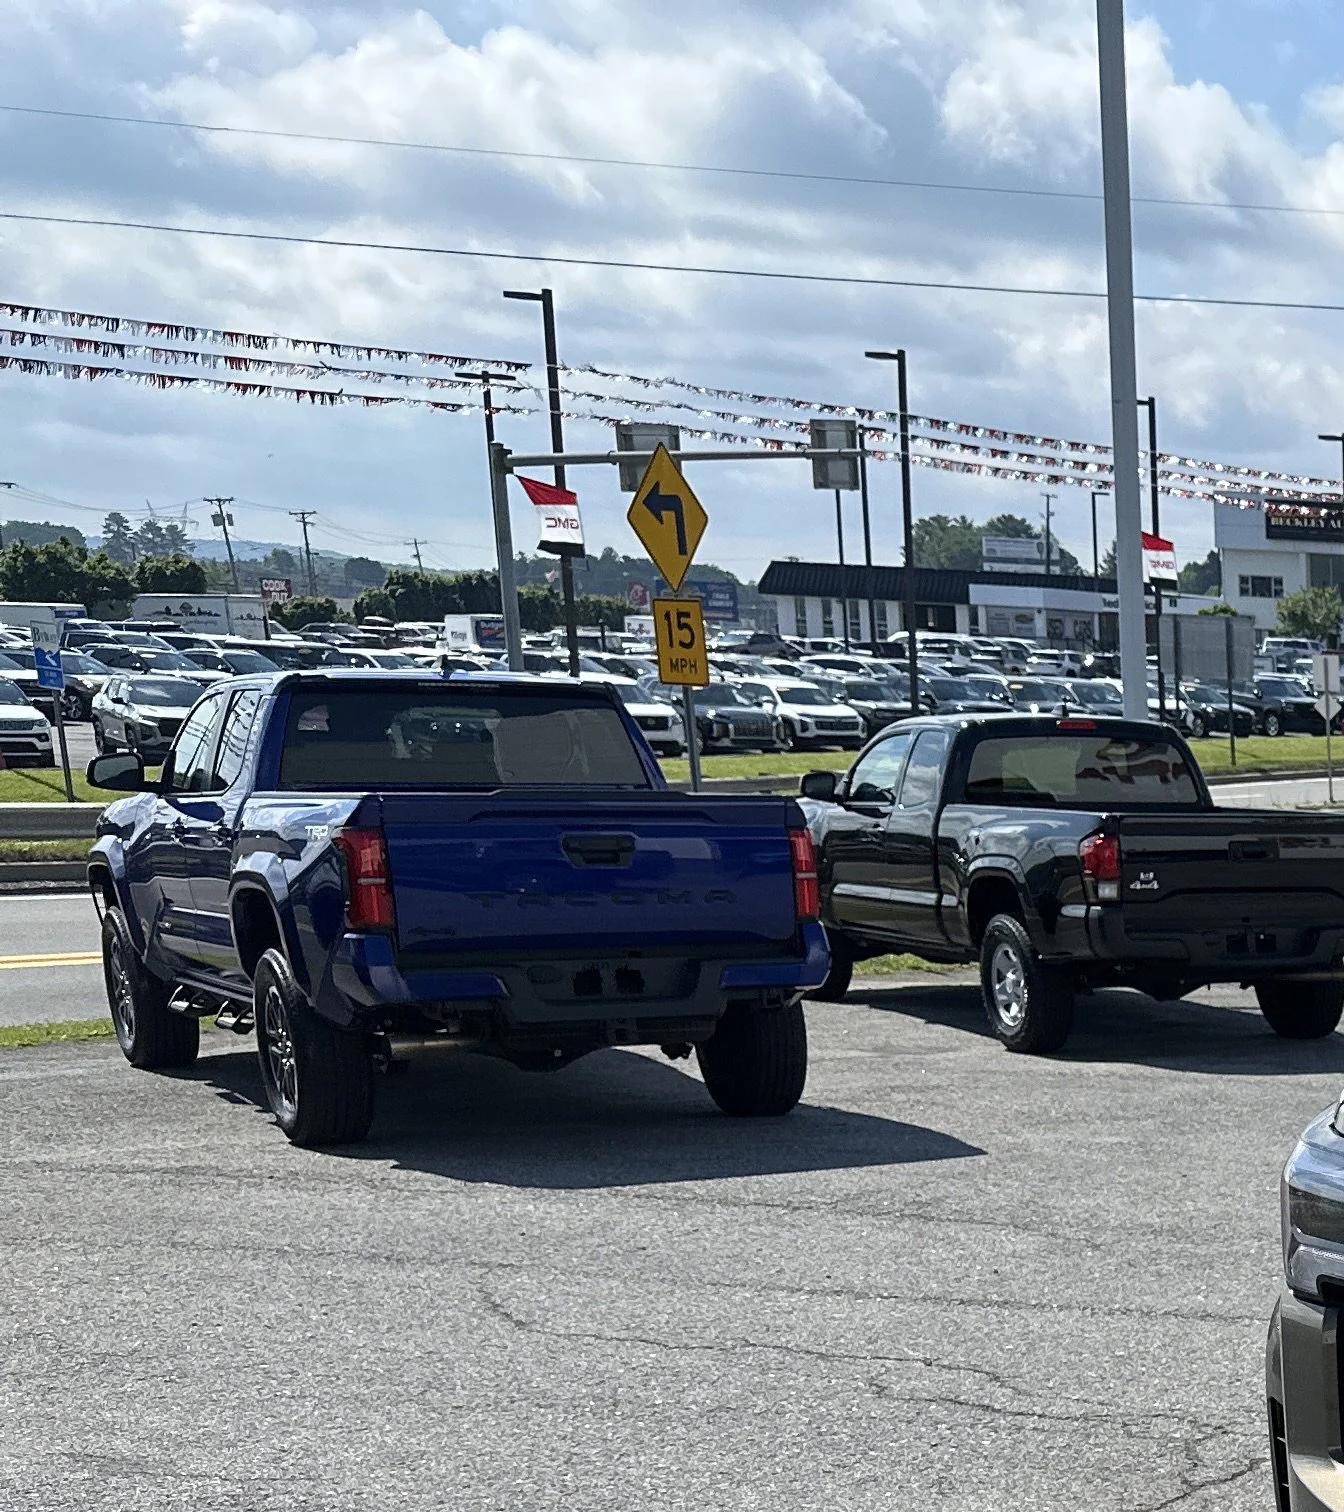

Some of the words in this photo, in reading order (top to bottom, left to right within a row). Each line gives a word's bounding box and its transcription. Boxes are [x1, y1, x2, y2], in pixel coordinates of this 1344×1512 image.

[262, 579, 288, 591] COOK
[663, 608, 696, 650] 15
[669, 658, 699, 675] MPH
[467, 890, 736, 908] TACOMA
